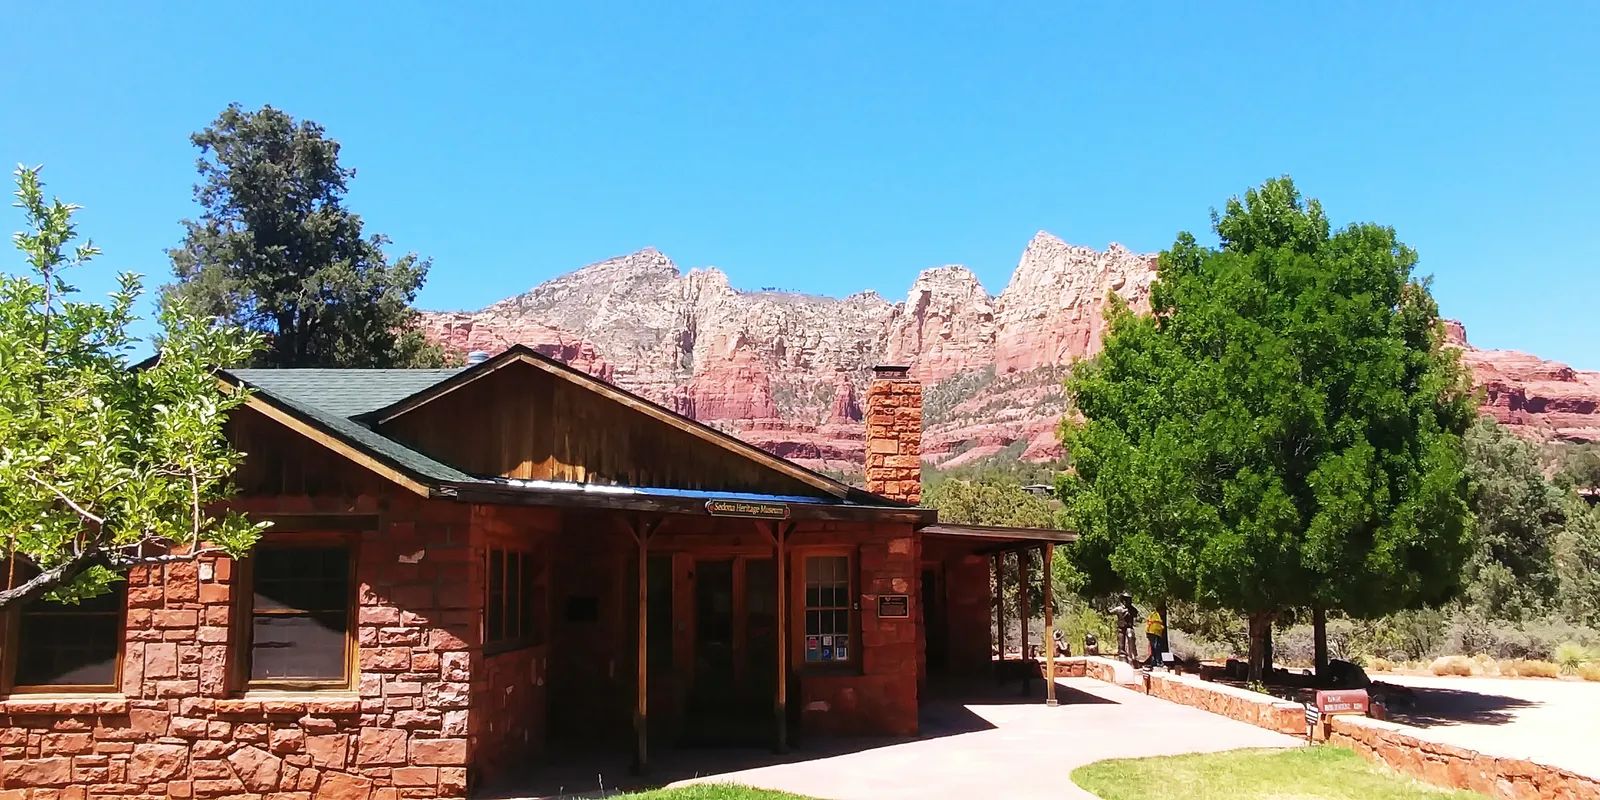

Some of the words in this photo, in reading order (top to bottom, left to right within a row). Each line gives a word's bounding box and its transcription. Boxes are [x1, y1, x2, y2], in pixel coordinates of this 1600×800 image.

[714, 502, 735, 512] Sedona
[736, 503, 760, 515] Heritage
[760, 505, 783, 514] Museum
